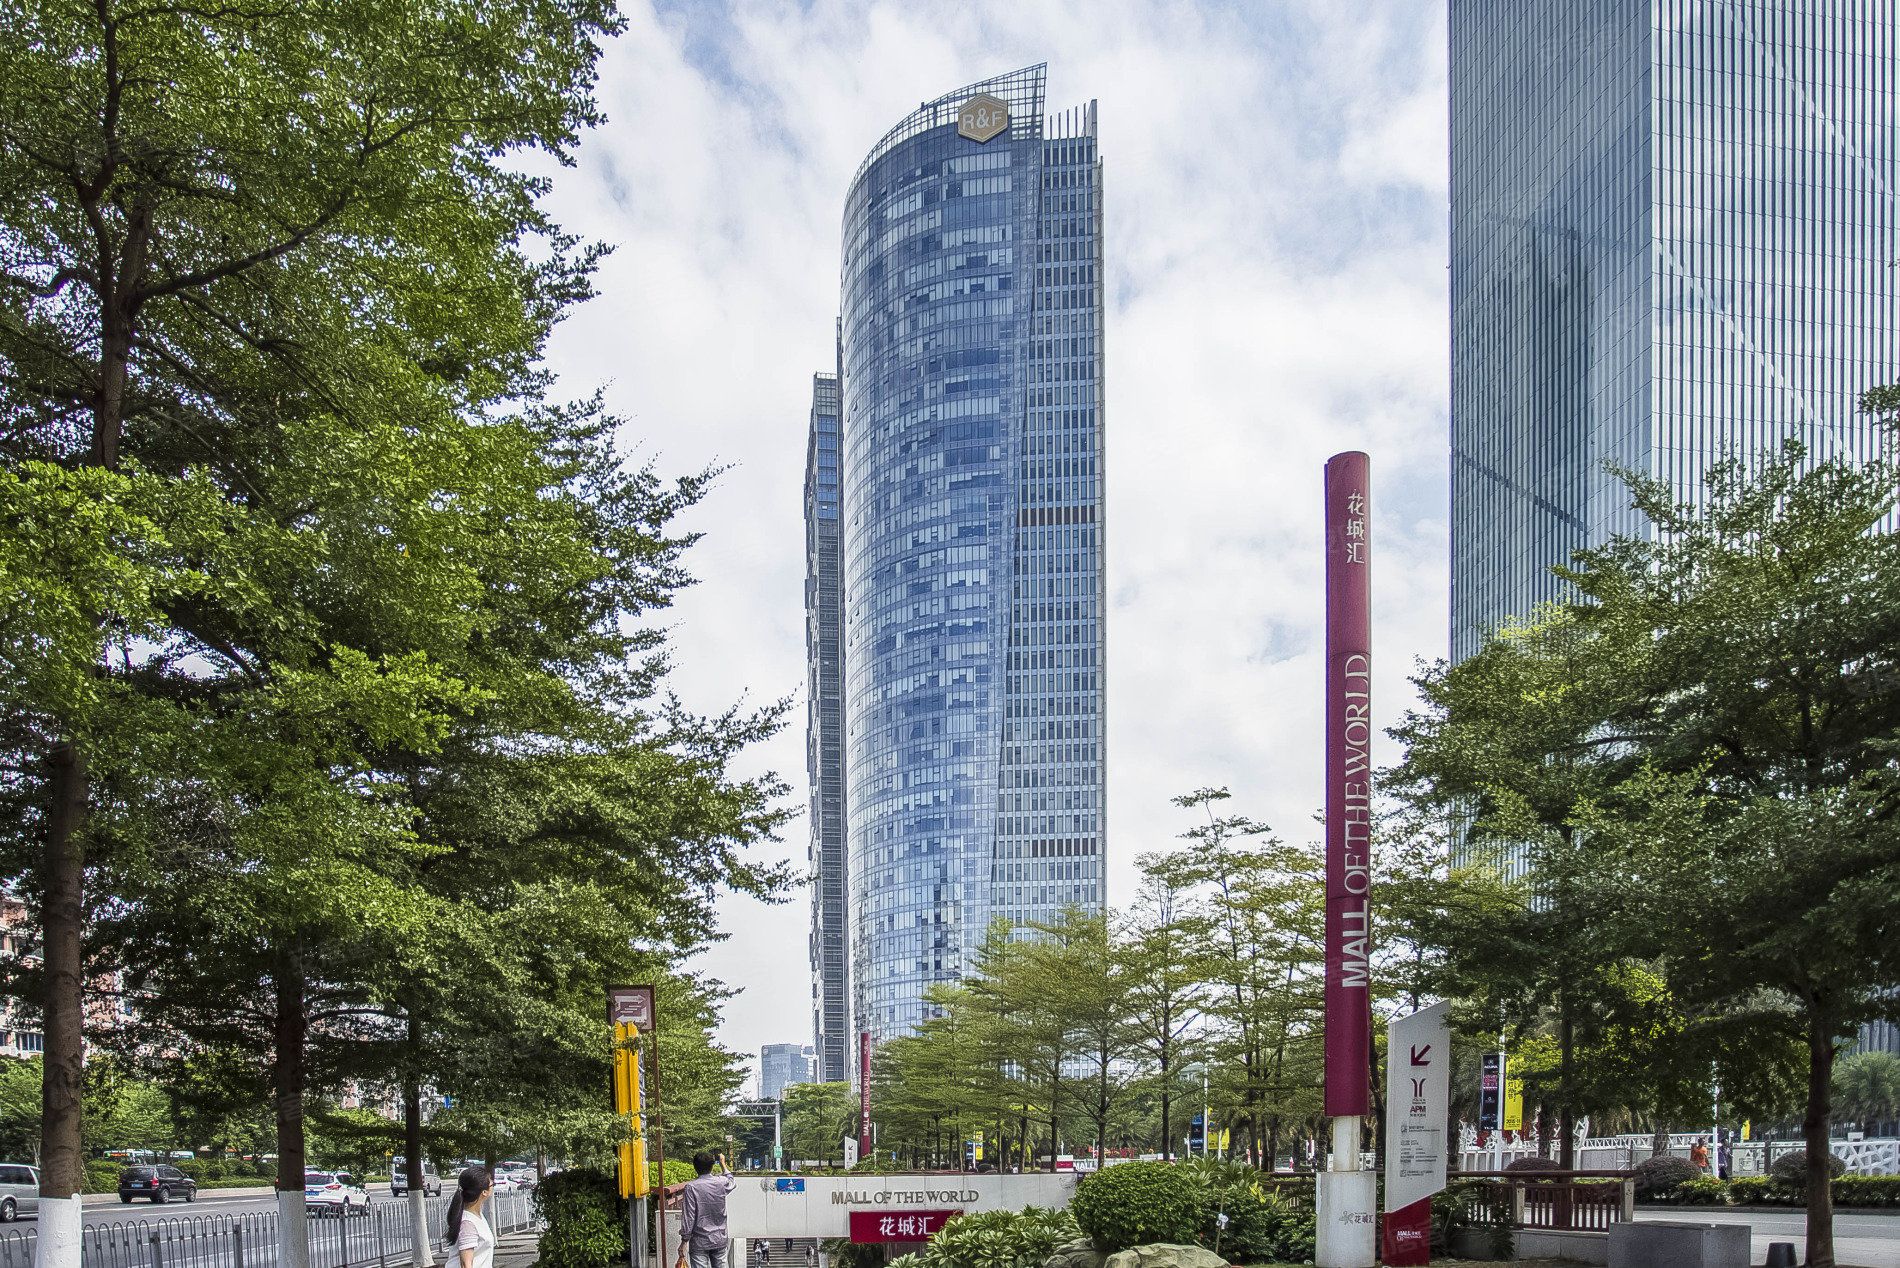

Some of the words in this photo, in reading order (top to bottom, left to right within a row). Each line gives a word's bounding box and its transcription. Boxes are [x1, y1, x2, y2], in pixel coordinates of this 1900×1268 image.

[962, 108, 1003, 130] R&F
[1346, 488, 1364, 563] 花城汇
[1345, 654, 1369, 777] WORLD
[1344, 781, 1368, 849] THE
[1344, 853, 1368, 894] OF
[1342, 899, 1368, 987] MALL
[832, 1191, 872, 1204] MALL
[874, 1191, 893, 1204] OF
[894, 1191, 924, 1204] THE
[925, 1190, 979, 1203] WORLD
[879, 1215, 934, 1236] 花城汇
